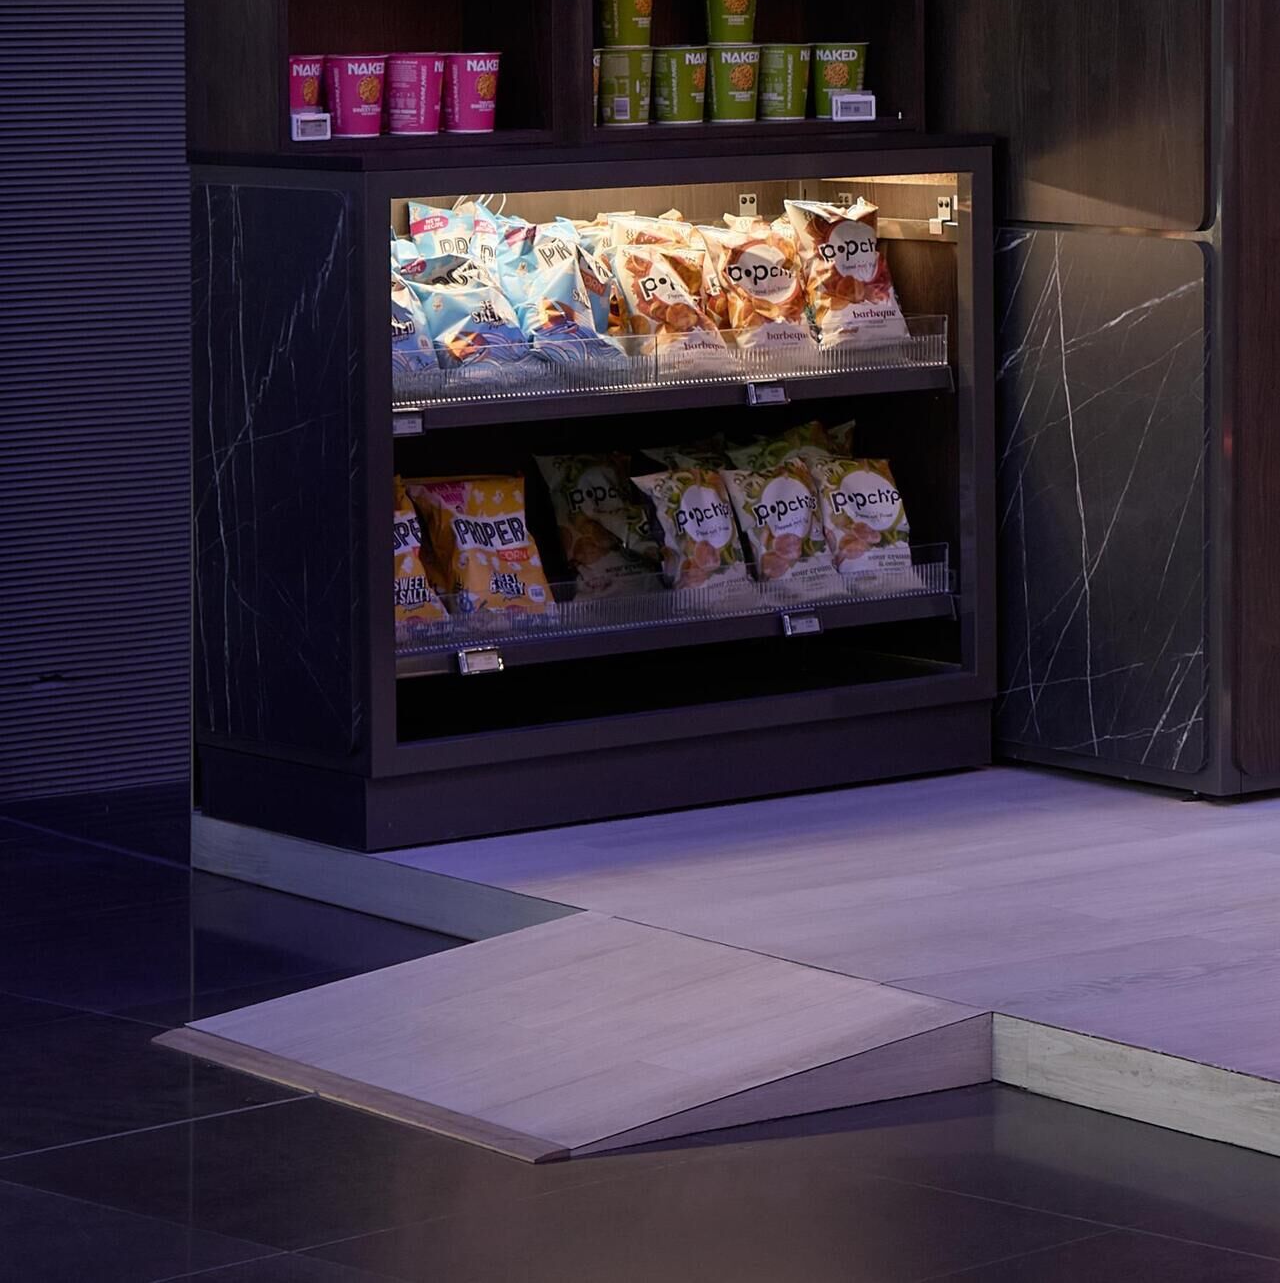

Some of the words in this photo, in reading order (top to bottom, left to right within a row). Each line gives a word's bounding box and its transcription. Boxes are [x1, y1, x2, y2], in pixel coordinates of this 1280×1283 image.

[721, 51, 760, 63] NAKED
[815, 49, 858, 62] NAKED
[852, 308, 897, 321] barbeque
